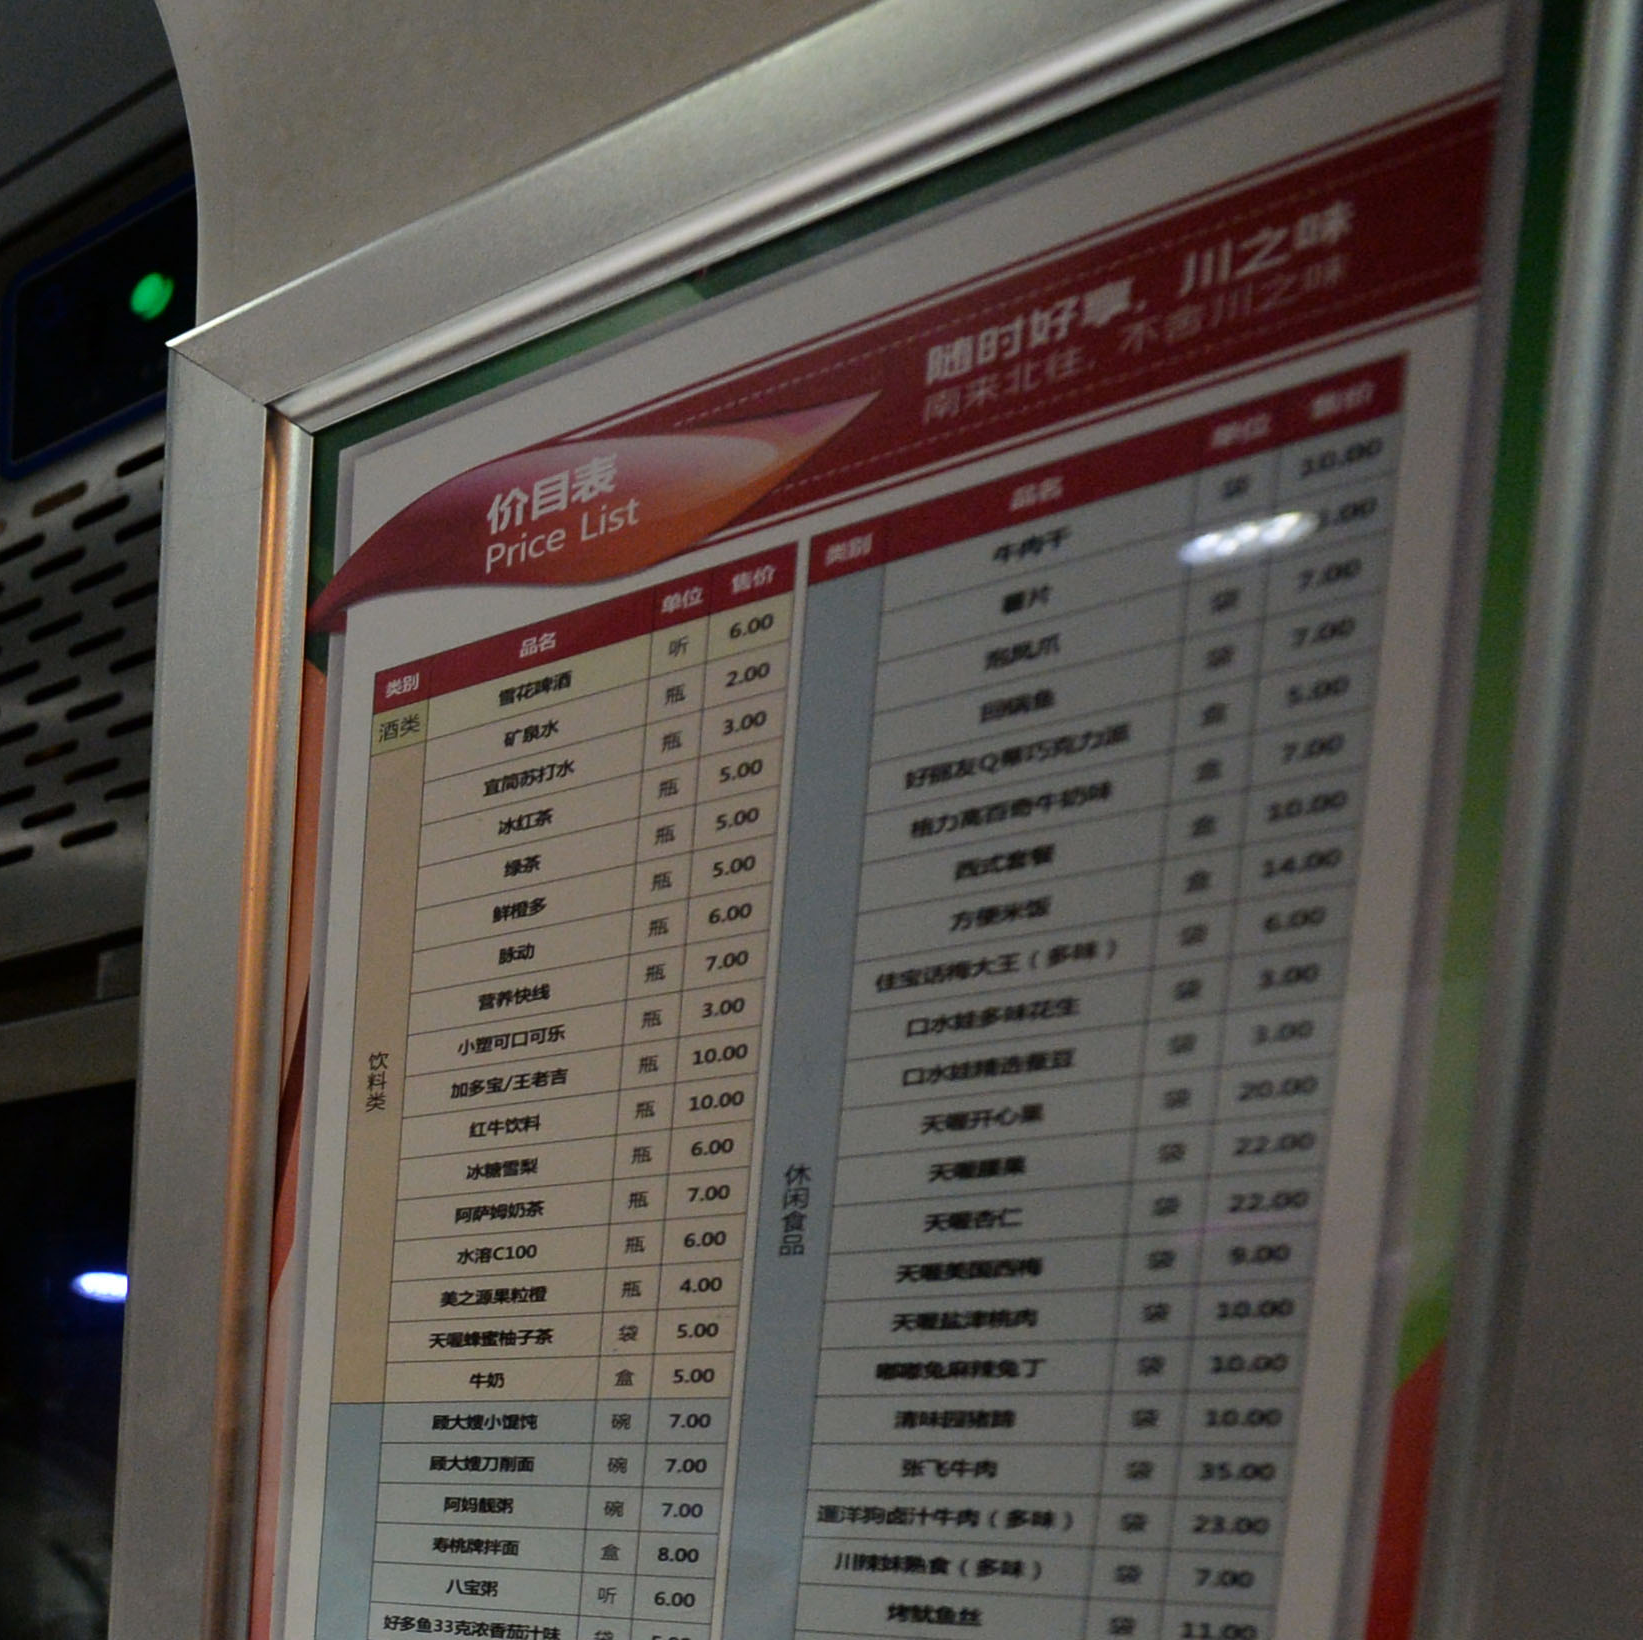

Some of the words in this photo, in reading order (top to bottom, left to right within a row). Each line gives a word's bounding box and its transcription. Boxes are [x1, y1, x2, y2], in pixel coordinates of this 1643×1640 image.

[487, 455, 618, 536] 价目表
[485, 527, 565, 574] Price
[580, 498, 641, 541] List
[384, 671, 421, 700] 类别
[518, 630, 558, 660] 品名
[660, 585, 704, 614] 单位
[730, 563, 777, 595] 售价
[497, 669, 573, 708] 雪花啤酒
[728, 612, 775, 641] 6.00
[502, 718, 560, 749] 矿泉水
[724, 660, 772, 689] 2.00
[722, 709, 769, 737] 3.00
[378, 712, 421, 744] 酒类
[496, 806, 554, 837] 冰红茶
[718, 757, 765, 784] 5.00
[502, 853, 542, 879] 绿茶
[715, 806, 761, 832] 5.00
[491, 896, 548, 925] 鲜橙多
[711, 853, 757, 880] 5.00
[707, 901, 754, 926] 6.00
[477, 982, 552, 1013] 营养快线
[705, 948, 750, 973] 7.00
[456, 1022, 566, 1058] 小塑可口可乐
[701, 996, 747, 1020] 3.00
[364, 1050, 390, 1114] 饮料类
[449, 1066, 569, 1100] 加多宝/王老吉
[692, 1042, 750, 1067] 10.00
[468, 1113, 542, 1139] 红牛饮料
[688, 1089, 746, 1113] 10.00
[689, 1136, 736, 1158] 6.00
[453, 1199, 546, 1225] 阿萨姆奶茶
[687, 1183, 732, 1204] 7.00
[777, 1163, 812, 1258] 休闲食品
[456, 1243, 539, 1266] 水溶C100
[682, 1229, 728, 1250] 6.00
[678, 1275, 724, 1294] 4.00
[676, 1321, 720, 1340] 5.00
[468, 1371, 506, 1390] 牛奶
[672, 1366, 717, 1385] 5.00
[669, 1412, 713, 1430] 7.00
[428, 1454, 536, 1474] 顾大嫂刀削面
[664, 1457, 709, 1475] 7.00
[900, 1457, 1000, 1481] 张飞牛肉
[661, 1501, 705, 1520] 7.00
[431, 1535, 520, 1558] 寿桃牌拌面
[656, 1545, 701, 1564] 8.00
[444, 1578, 500, 1599] 八宝粥
[652, 1590, 697, 1609] 6.00
